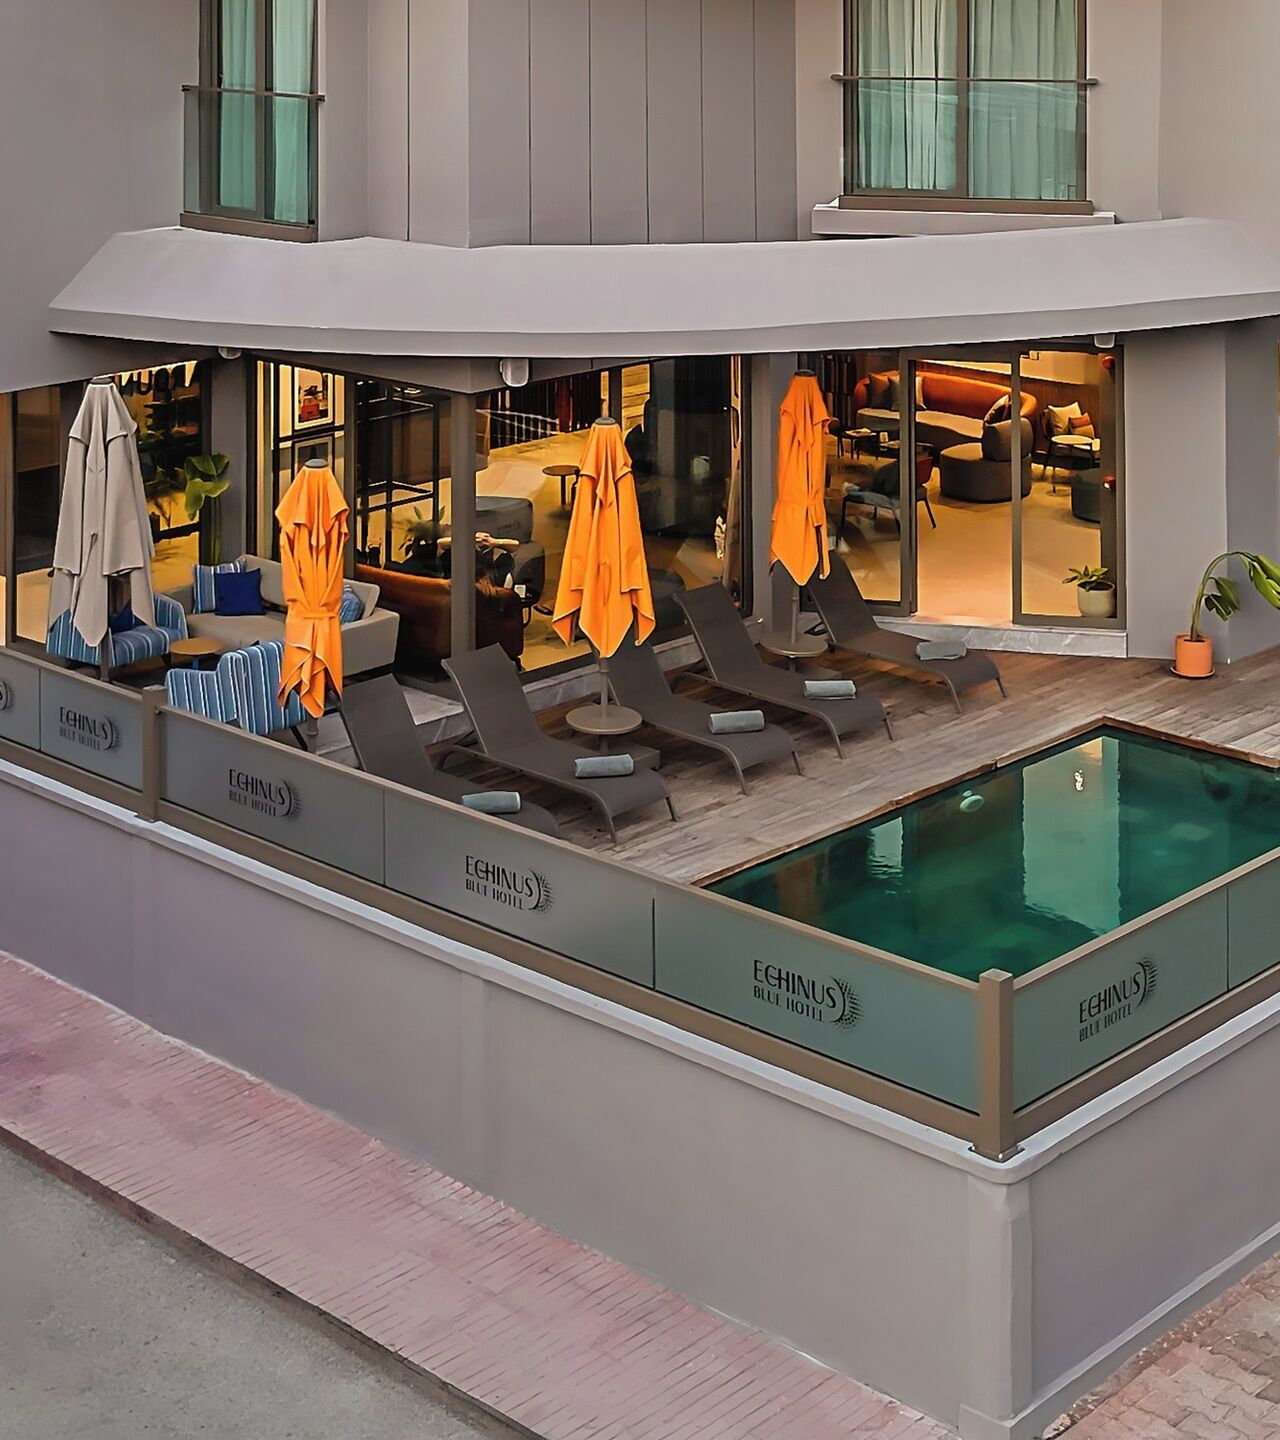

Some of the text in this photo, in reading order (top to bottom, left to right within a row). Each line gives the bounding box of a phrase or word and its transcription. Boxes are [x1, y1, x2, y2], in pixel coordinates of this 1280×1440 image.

[60, 706, 108, 740] ECHINUS
[229, 768, 285, 805] ECHINUS
[465, 855, 533, 898] ECHINUS
[465, 878, 524, 911] BLUE HOTEL
[753, 959, 837, 1009] ECHINUS
[1079, 971, 1141, 1024] ECHINUS
[753, 984, 824, 1023] BLUE HOTEL
[1079, 1006, 1133, 1042] BLUE HOTEL
